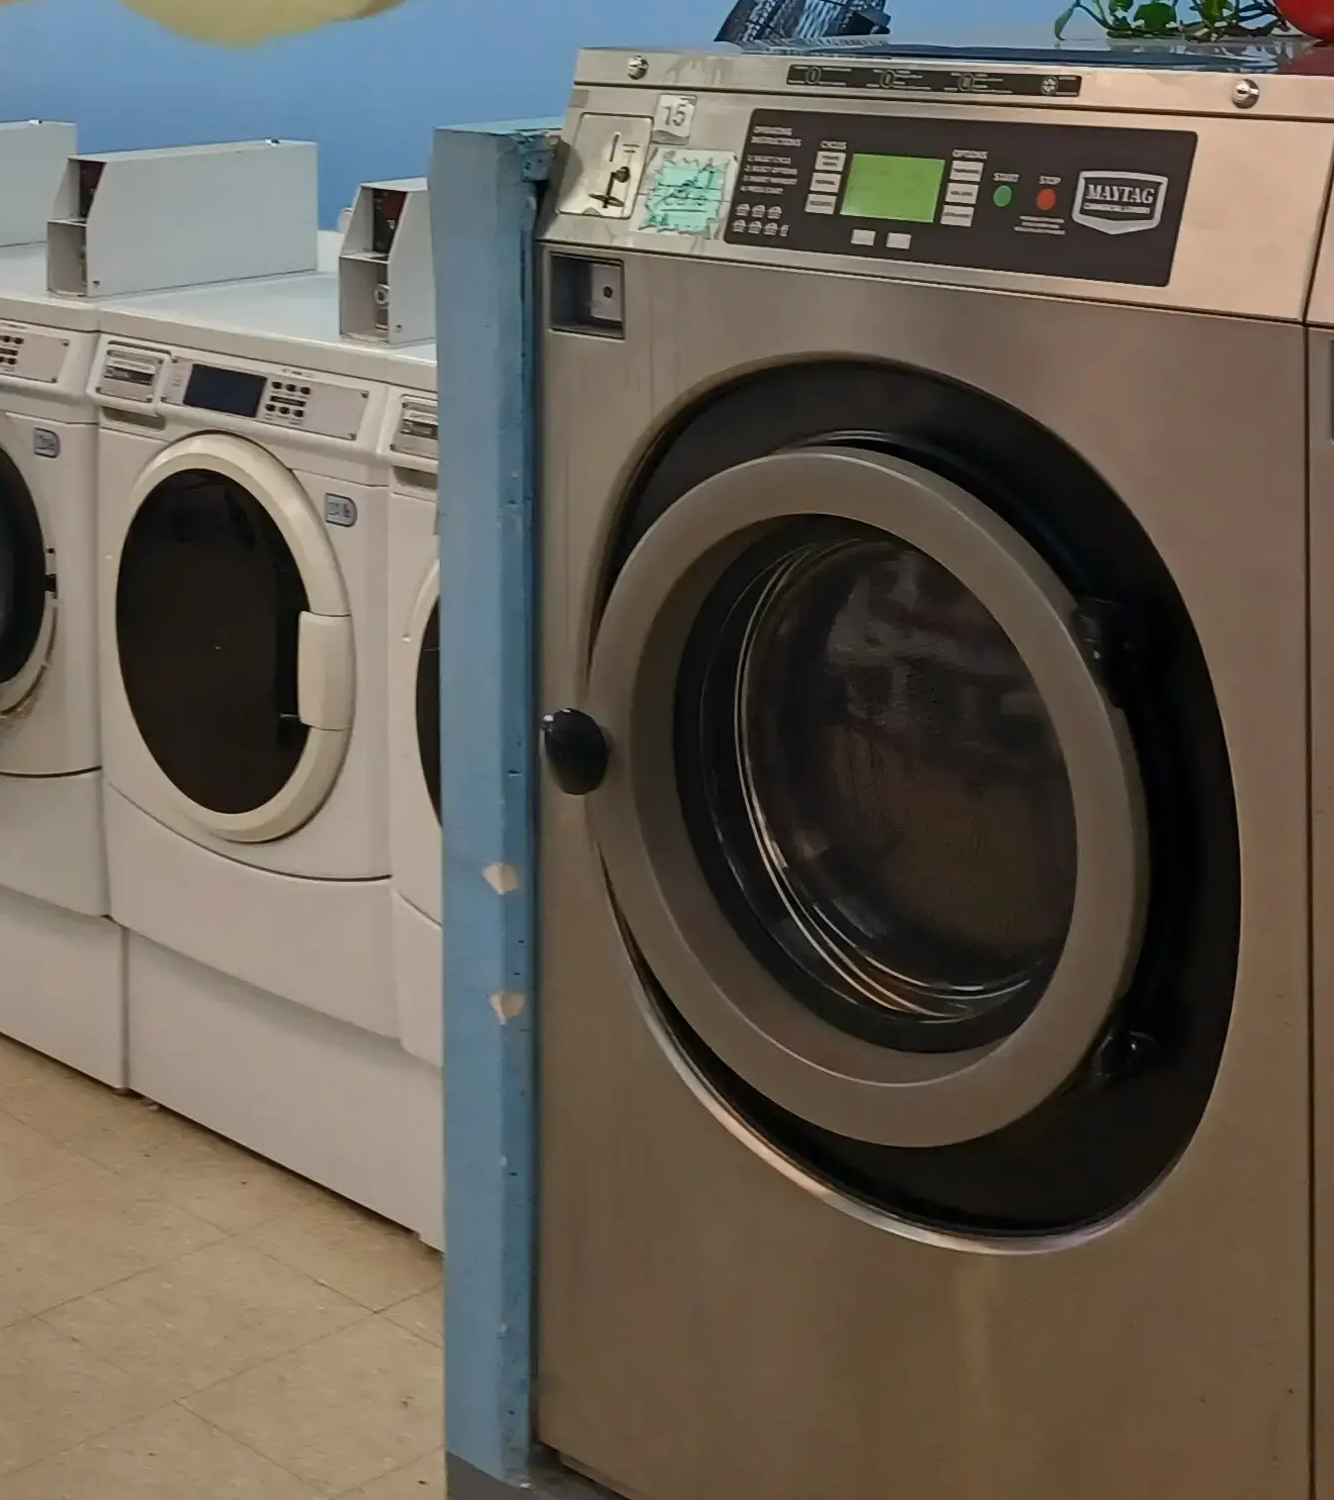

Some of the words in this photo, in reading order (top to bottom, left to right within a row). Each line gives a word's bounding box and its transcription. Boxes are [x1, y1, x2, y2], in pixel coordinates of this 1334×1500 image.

[664, 103, 687, 127] 15
[1039, 175, 1062, 186] STOP
[1085, 184, 1155, 204] MAYTAG
